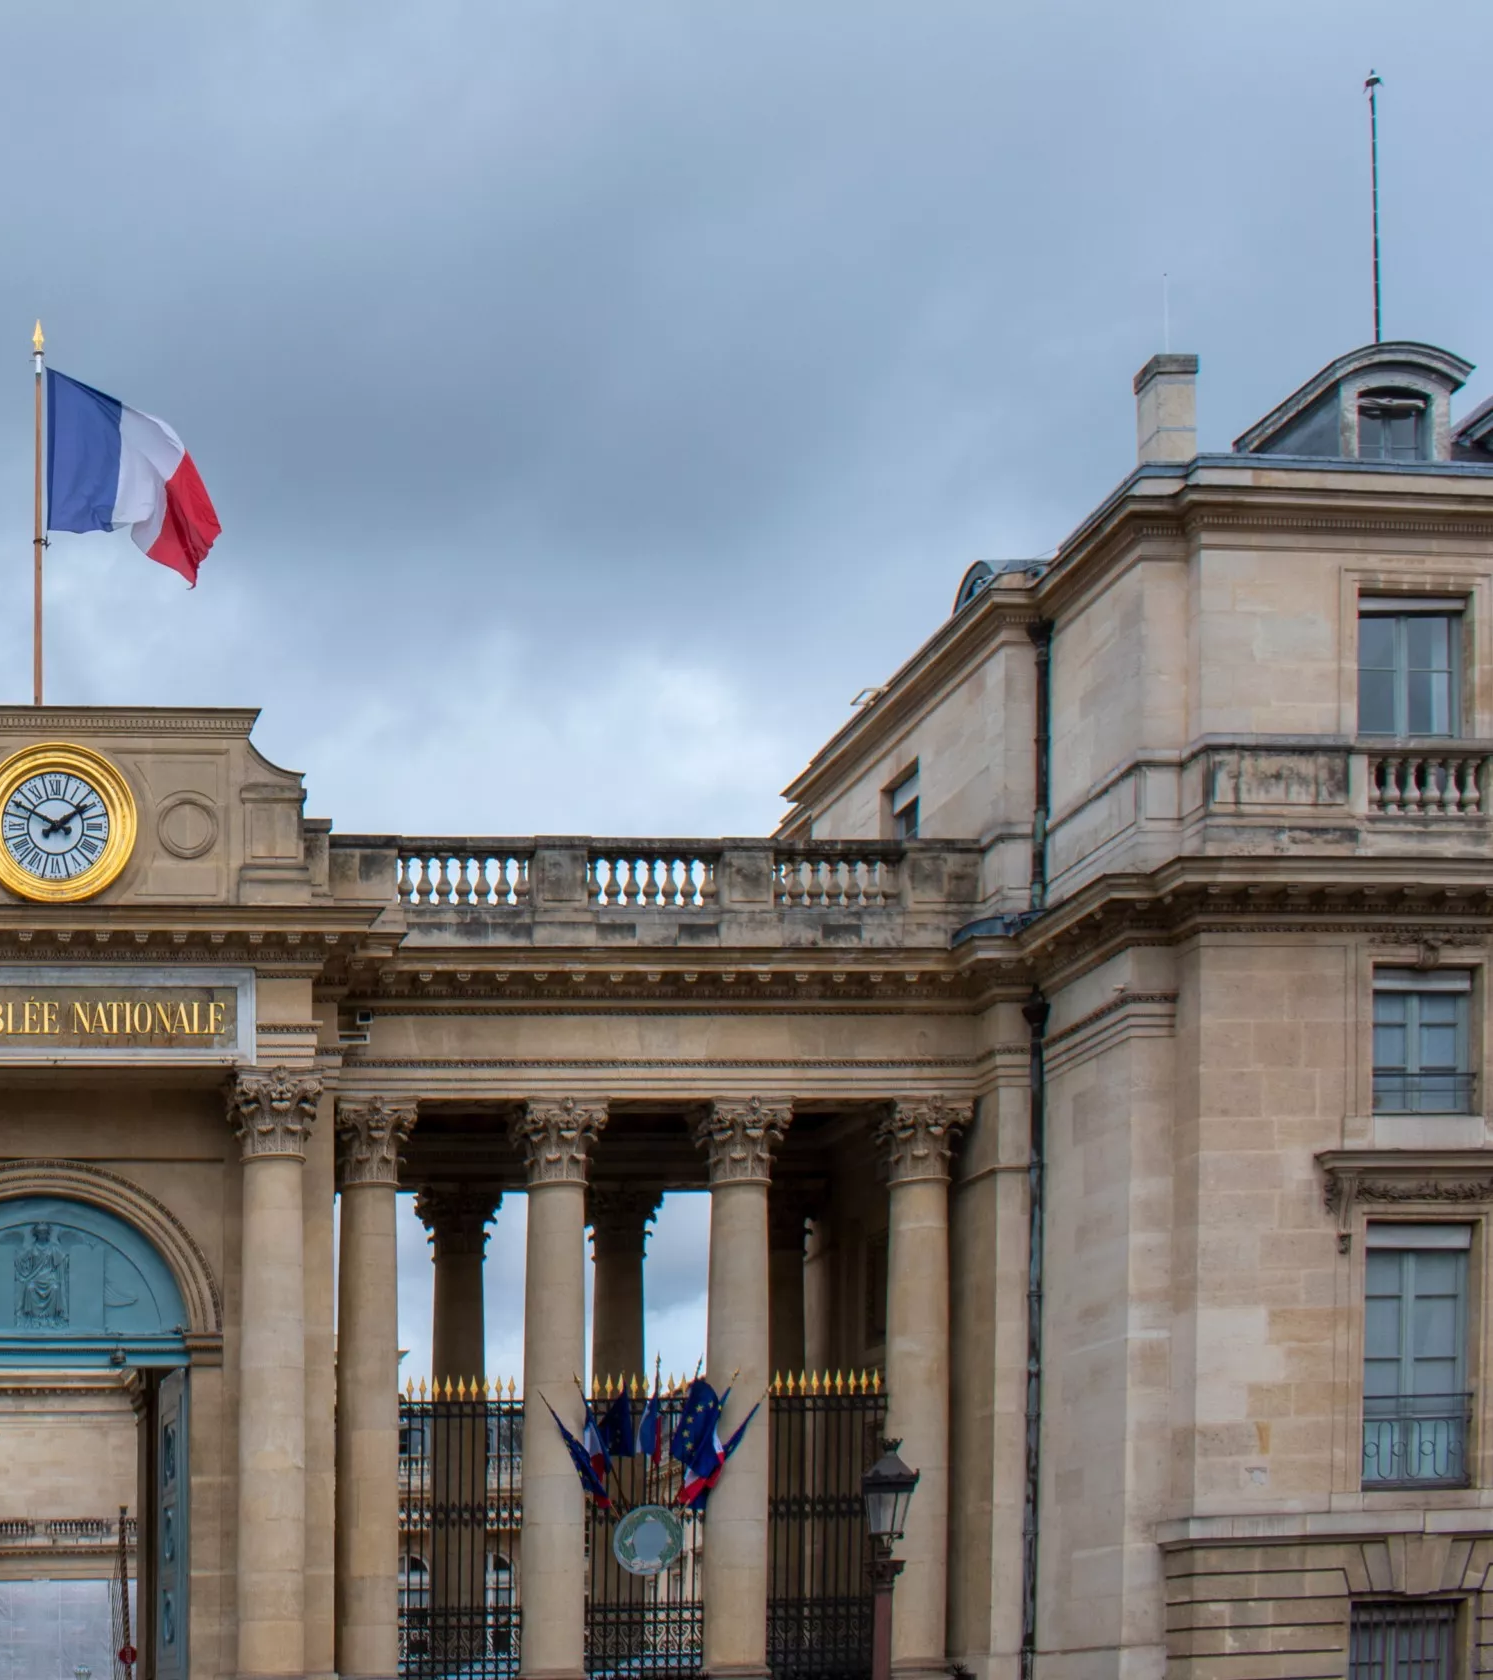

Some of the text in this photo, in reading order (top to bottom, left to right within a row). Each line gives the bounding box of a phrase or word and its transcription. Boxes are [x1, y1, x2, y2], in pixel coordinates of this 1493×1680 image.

[28, 784, 43, 801] XI
[48, 779, 61, 796] XII
[70, 785, 80, 800] I
[8, 820, 25, 831] IX
[86, 823, 102, 831] III
[12, 837, 31, 857] VIII
[80, 838, 98, 855] IIII
[27, 851, 43, 870] VII
[50, 857, 61, 873] VI
[70, 853, 81, 869] V
[73, 1001, 225, 1034] NATIONALE
